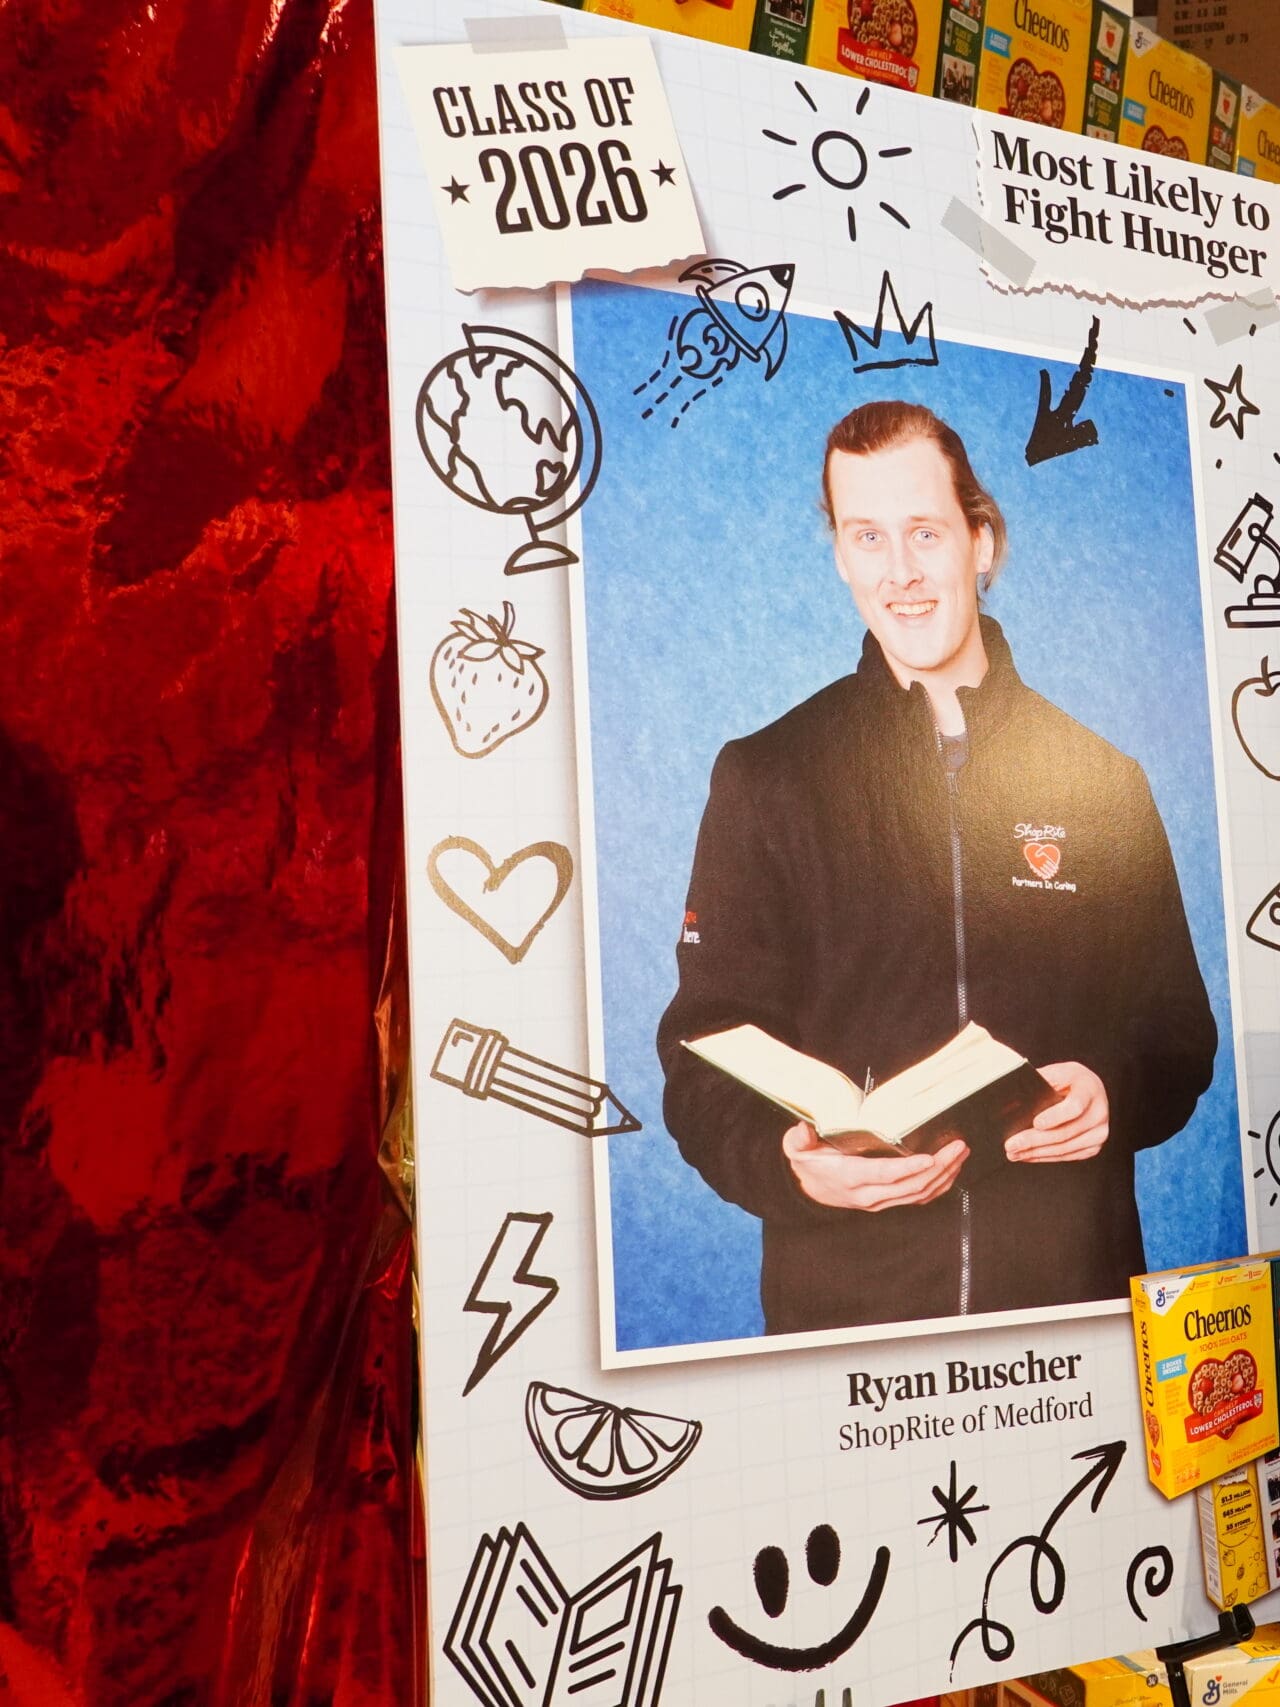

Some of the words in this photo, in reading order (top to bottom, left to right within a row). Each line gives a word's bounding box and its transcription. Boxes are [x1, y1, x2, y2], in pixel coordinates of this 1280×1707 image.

[1014, 0, 1070, 52] Cheerios
[841, 44, 865, 66] LOWER
[865, 56, 908, 79] CHOLESTEROL
[432, 81, 577, 139] CLASS
[583, 77, 636, 128] OF
[1148, 70, 1194, 119] Cheerios
[478, 139, 649, 235] 2026
[991, 130, 1095, 190] Most
[1104, 157, 1224, 228] Likely
[1232, 192, 1270, 231] to
[1001, 183, 1114, 244] Fight
[1122, 211, 1267, 279] Hunger
[1013, 823, 1066, 842] ShopRite
[1012, 876, 1043, 889] Partners
[1054, 881, 1077, 893] Caring
[1184, 1303, 1252, 1341] Cheerios
[1230, 1332, 1248, 1343] OATS
[847, 1368, 938, 1412] Ryan
[946, 1350, 1082, 1394] Buscher
[1140, 1320, 1155, 1408] Cheerios
[838, 1413, 955, 1450] ShopRite
[962, 1404, 989, 1433] of
[993, 1391, 1093, 1430] Medford
[1190, 1421, 1213, 1436] LOWER
[1213, 1400, 1254, 1426] CHOLESTEROL
[1222, 1680, 1248, 1689] General
